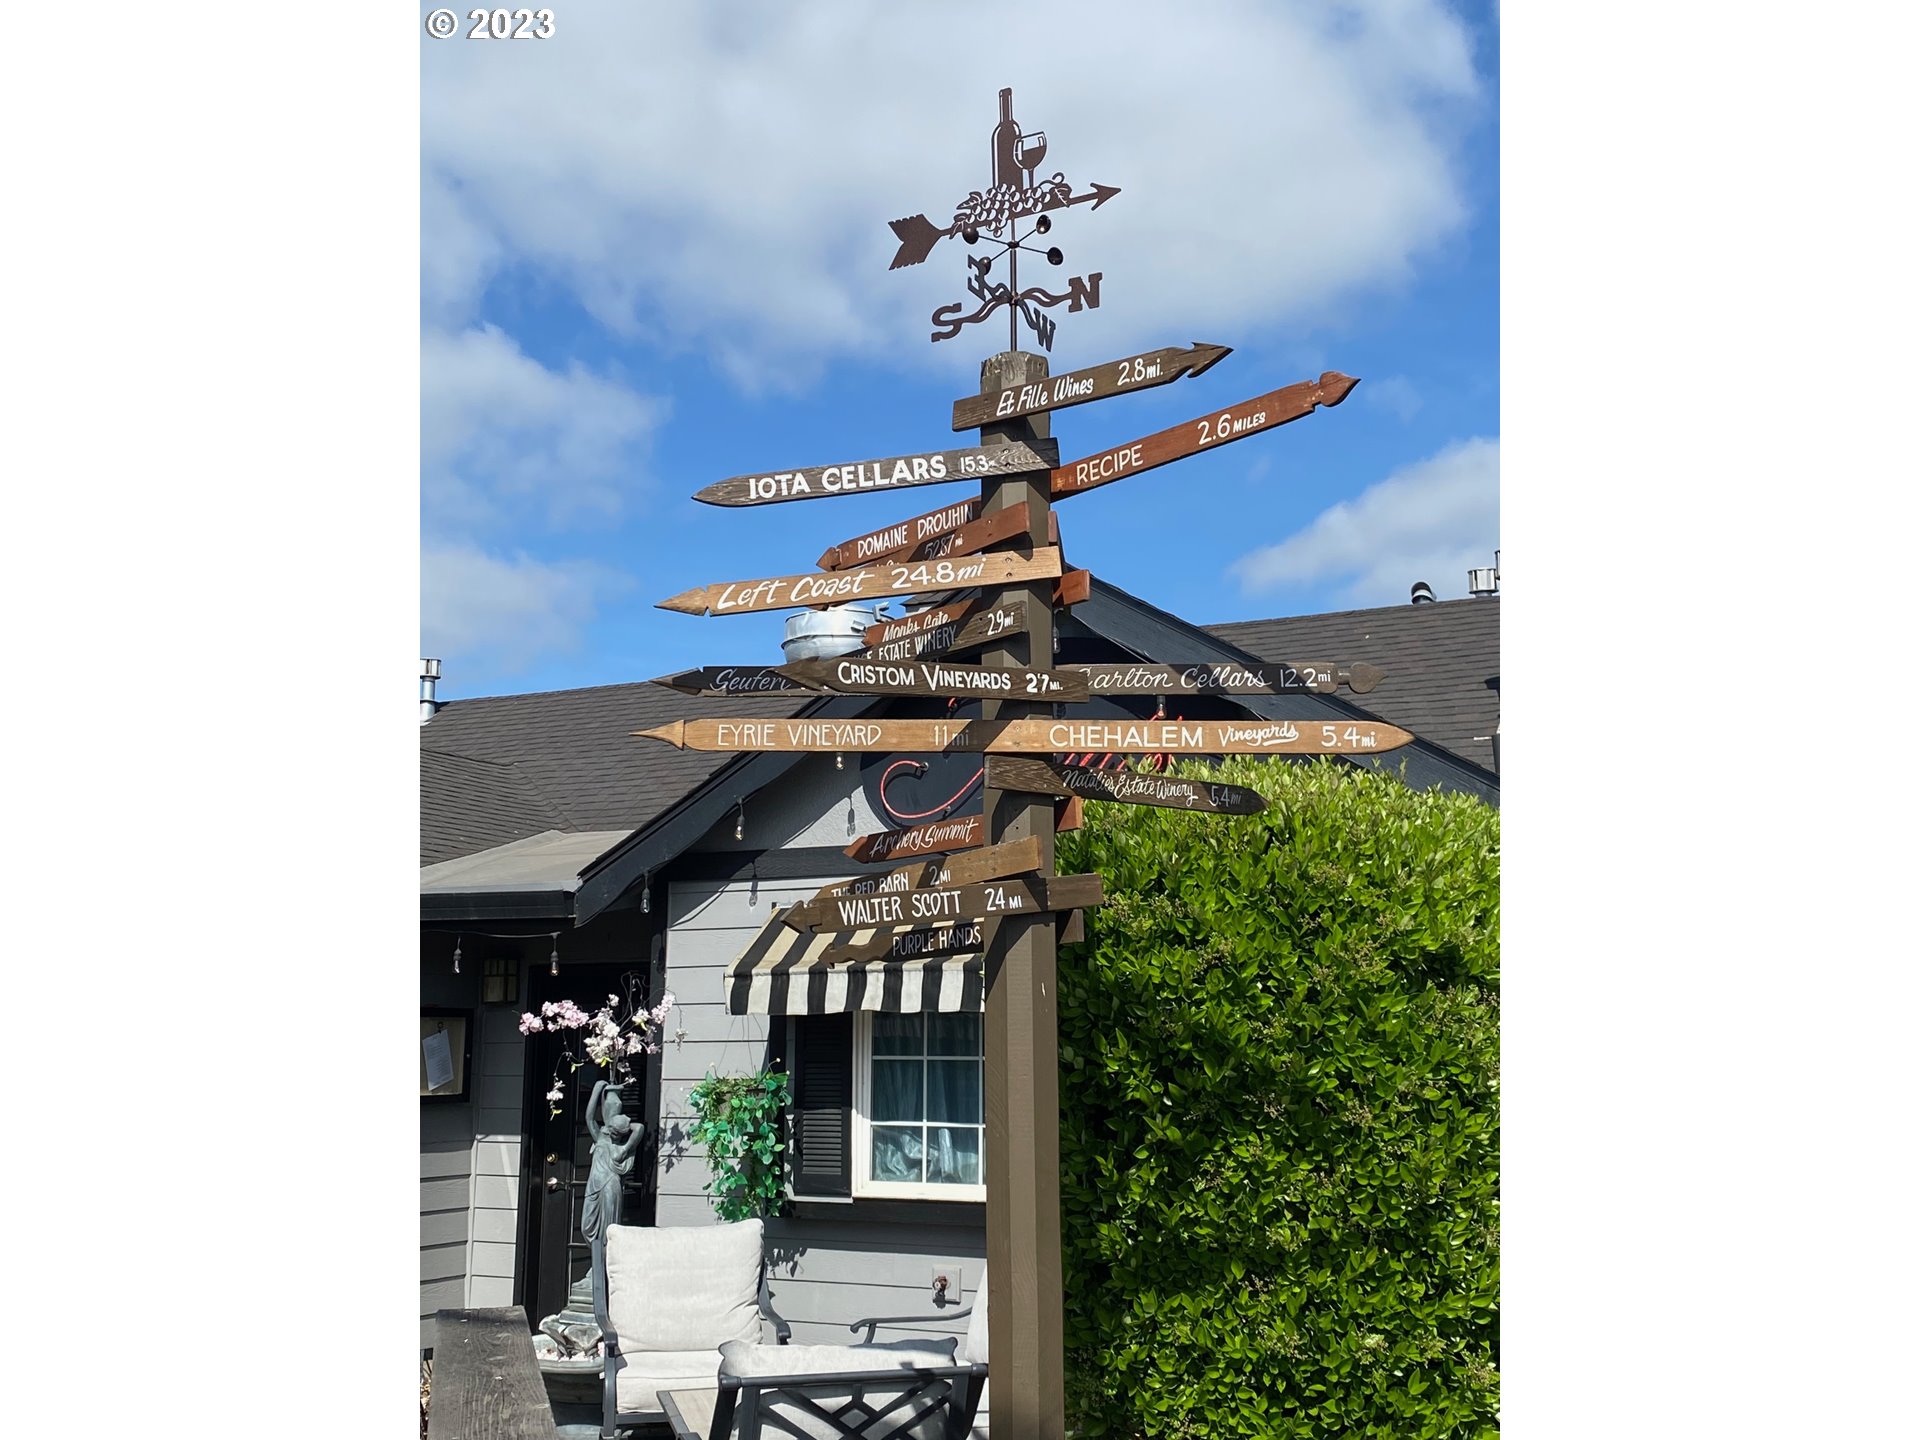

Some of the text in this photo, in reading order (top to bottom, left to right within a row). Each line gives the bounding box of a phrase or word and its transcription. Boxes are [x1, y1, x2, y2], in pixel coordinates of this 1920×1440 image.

[996, 390, 1015, 417] Et
[1016, 383, 1049, 412] Fille
[1053, 375, 1094, 403] Wines
[748, 454, 989, 501] IOTA CELLARS 15.3
[1076, 444, 1144, 486] RECIPE
[857, 503, 973, 559] DOMAINE DROUHIN
[717, 580, 787, 610] Left
[790, 571, 874, 601] Coast
[878, 639, 911, 661] ESTATE
[914, 624, 957, 656] WINERY
[882, 618, 920, 643] Monks
[838, 661, 915, 686] CRISTOM
[921, 664, 1012, 691] VINEYARDS
[1180, 665, 1272, 688] Cellars
[717, 724, 775, 747] EYRIE
[787, 724, 882, 747] VINEYARD
[1049, 724, 1203, 748] CHEHALEM
[1218, 721, 1299, 747] Vineyards
[1113, 773, 1156, 799] Estate
[1155, 780, 1199, 807] Winery
[869, 818, 979, 858] Archery Summit
[880, 871, 909, 893] BARN
[838, 896, 904, 926] WALTER
[911, 891, 962, 918] SCOTT
[893, 926, 982, 957] PURPLE HANDS
